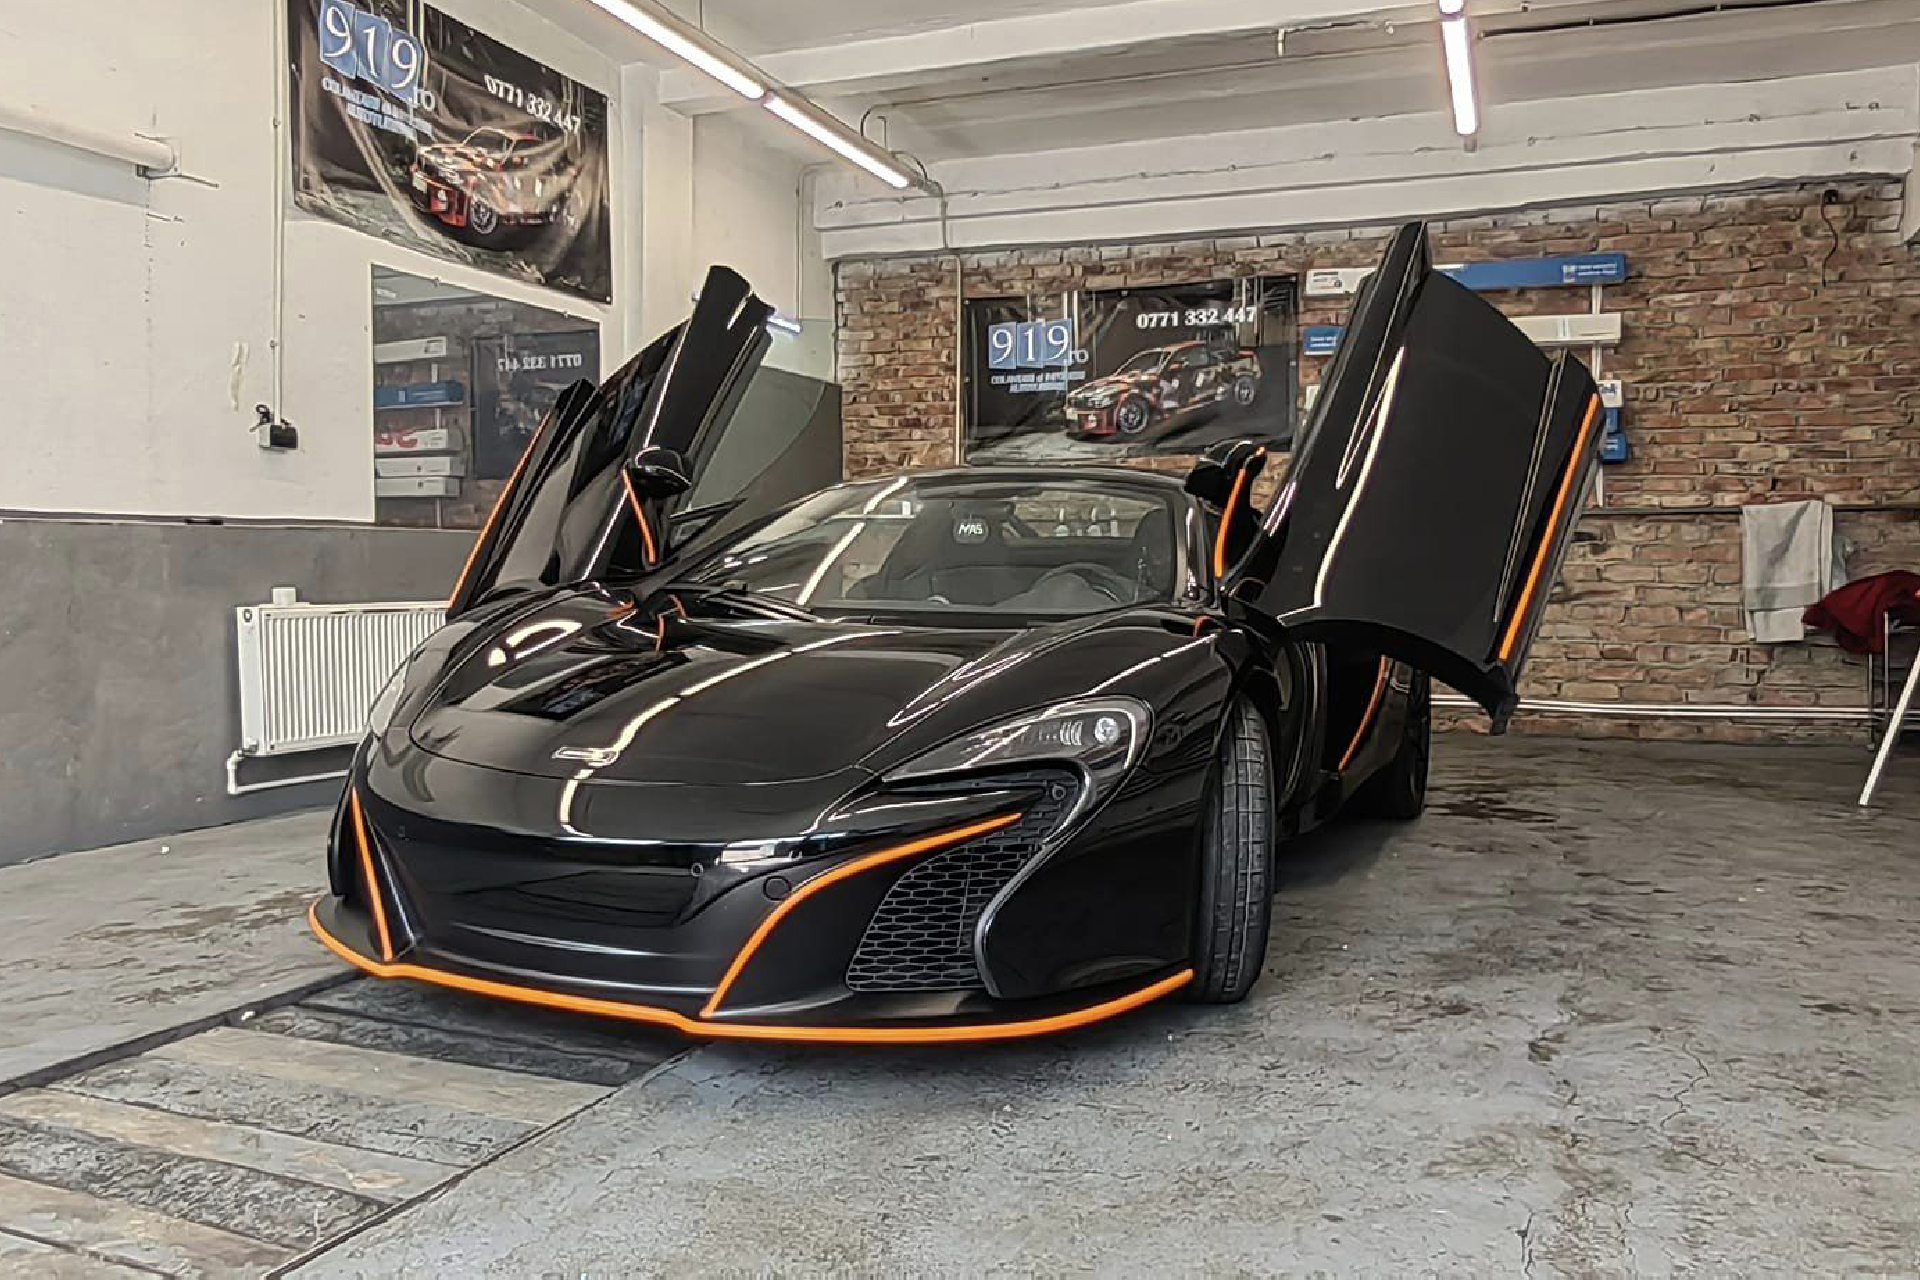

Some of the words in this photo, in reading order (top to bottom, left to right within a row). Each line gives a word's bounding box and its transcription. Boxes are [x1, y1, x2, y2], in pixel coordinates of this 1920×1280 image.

[323, 6, 418, 89] 919
[484, 74, 524, 108] 0771
[527, 92, 552, 123] 332
[552, 108, 581, 134] 447
[1136, 311, 1179, 328] 0771
[1184, 308, 1219, 326] 332
[1222, 305, 1257, 323] 447
[991, 325, 1069, 365] 919
